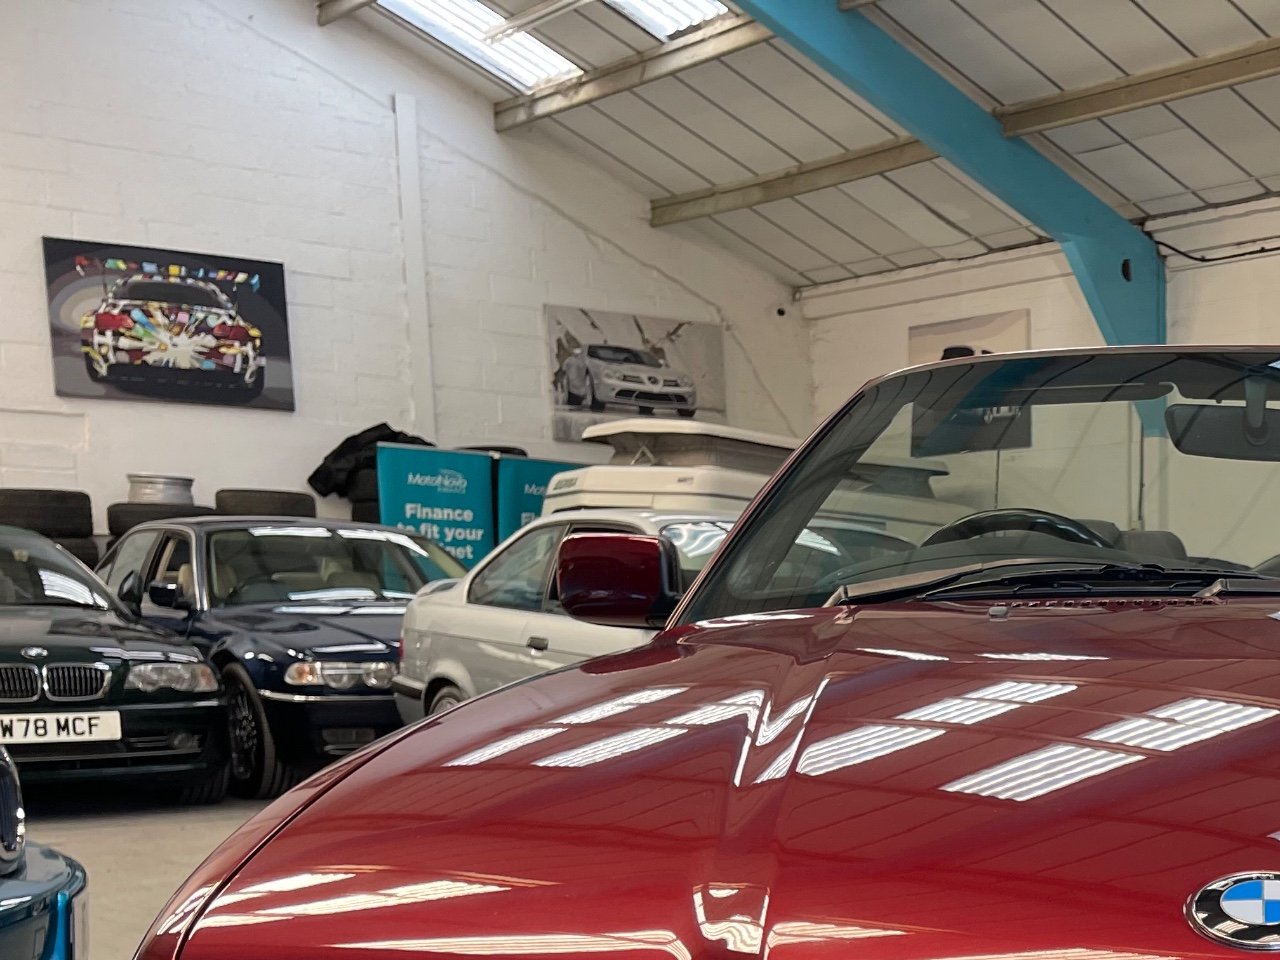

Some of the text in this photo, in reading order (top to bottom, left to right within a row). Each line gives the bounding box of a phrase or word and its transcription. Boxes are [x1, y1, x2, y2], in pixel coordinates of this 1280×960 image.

[405, 502, 474, 522] Finance
[445, 527, 484, 542] your
[1, 716, 100, 738] W78 MCF
